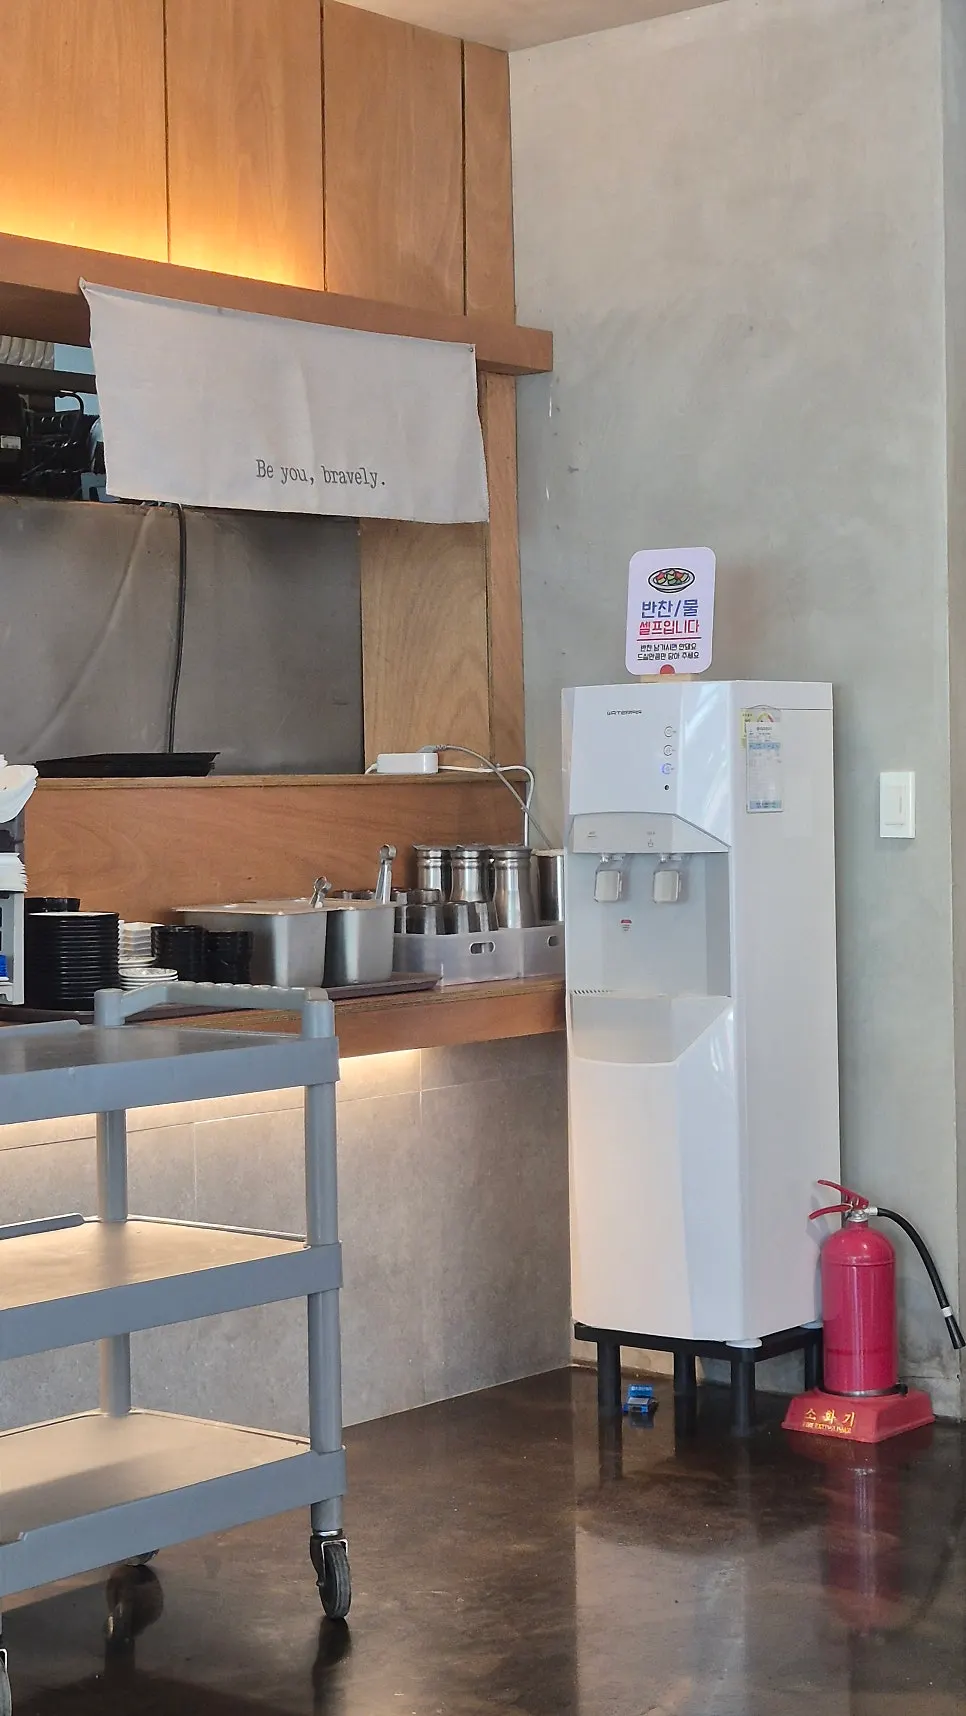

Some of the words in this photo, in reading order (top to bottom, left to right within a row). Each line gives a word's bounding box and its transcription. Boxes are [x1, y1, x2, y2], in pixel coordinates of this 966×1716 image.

[256, 459, 274, 479] Be
[280, 465, 315, 485] you,
[320, 465, 386, 489] bravely.
[641, 599, 699, 618] 반찬/물
[639, 619, 700, 636] 셀프입니다
